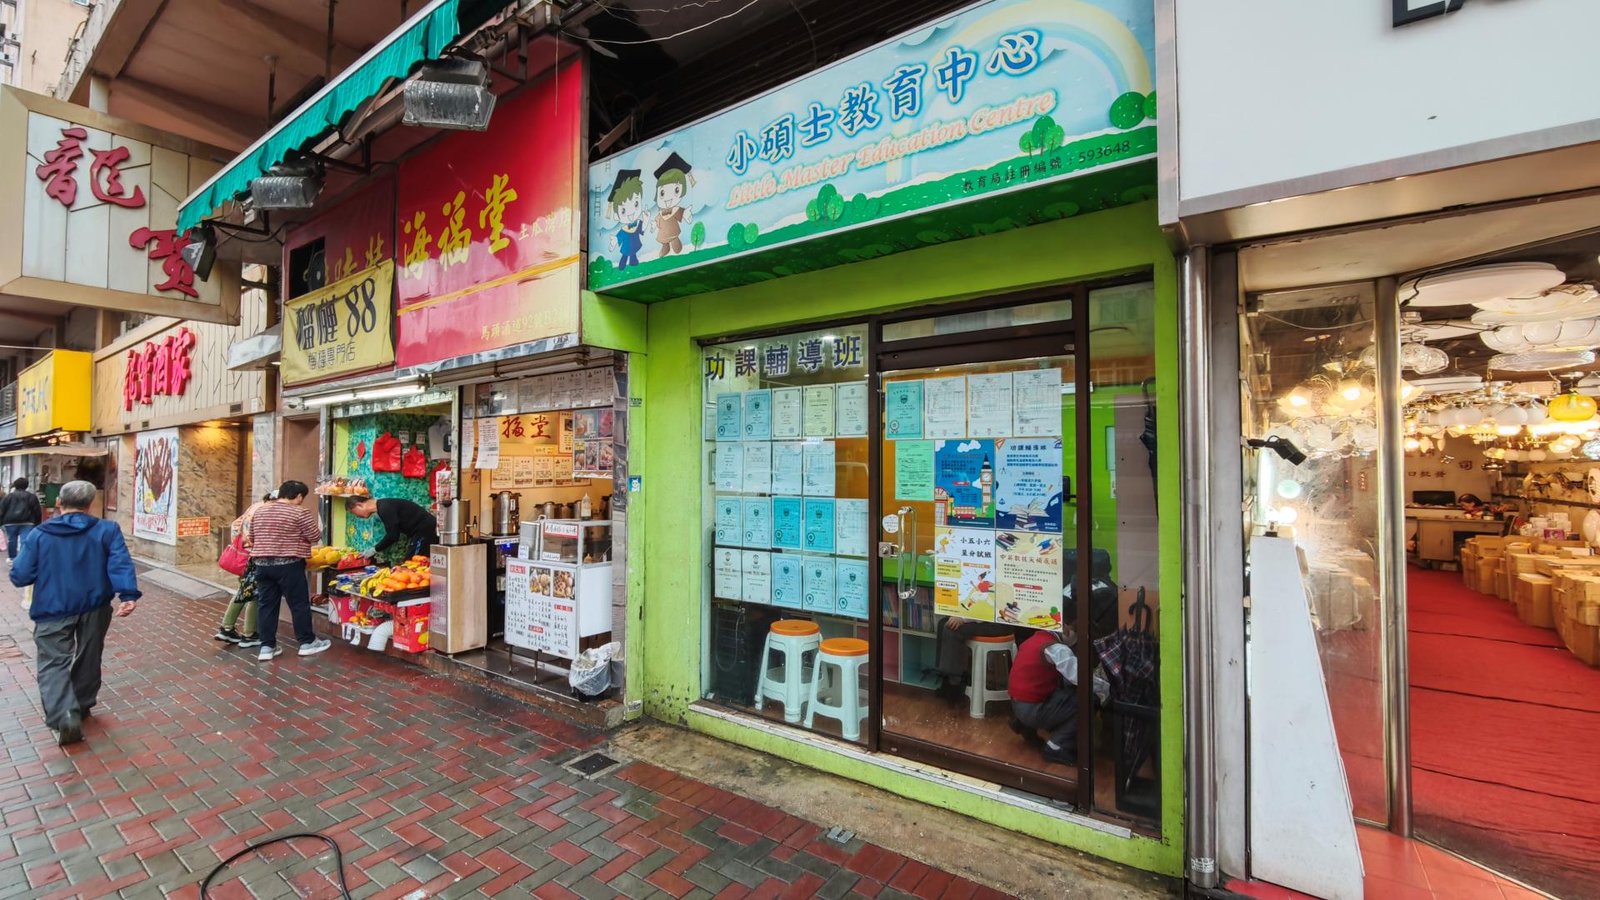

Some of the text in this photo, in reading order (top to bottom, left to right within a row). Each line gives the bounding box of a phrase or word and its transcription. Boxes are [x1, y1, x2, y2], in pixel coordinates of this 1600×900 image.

[728, 32, 1040, 173] 小碩士教育中心
[729, 92, 1054, 207] Little Master Education Centre
[403, 174, 518, 280] 海福堂
[344, 277, 376, 337] 88
[705, 336, 861, 380] 功課輔導班
[960, 536, 991, 545] 小五小六
